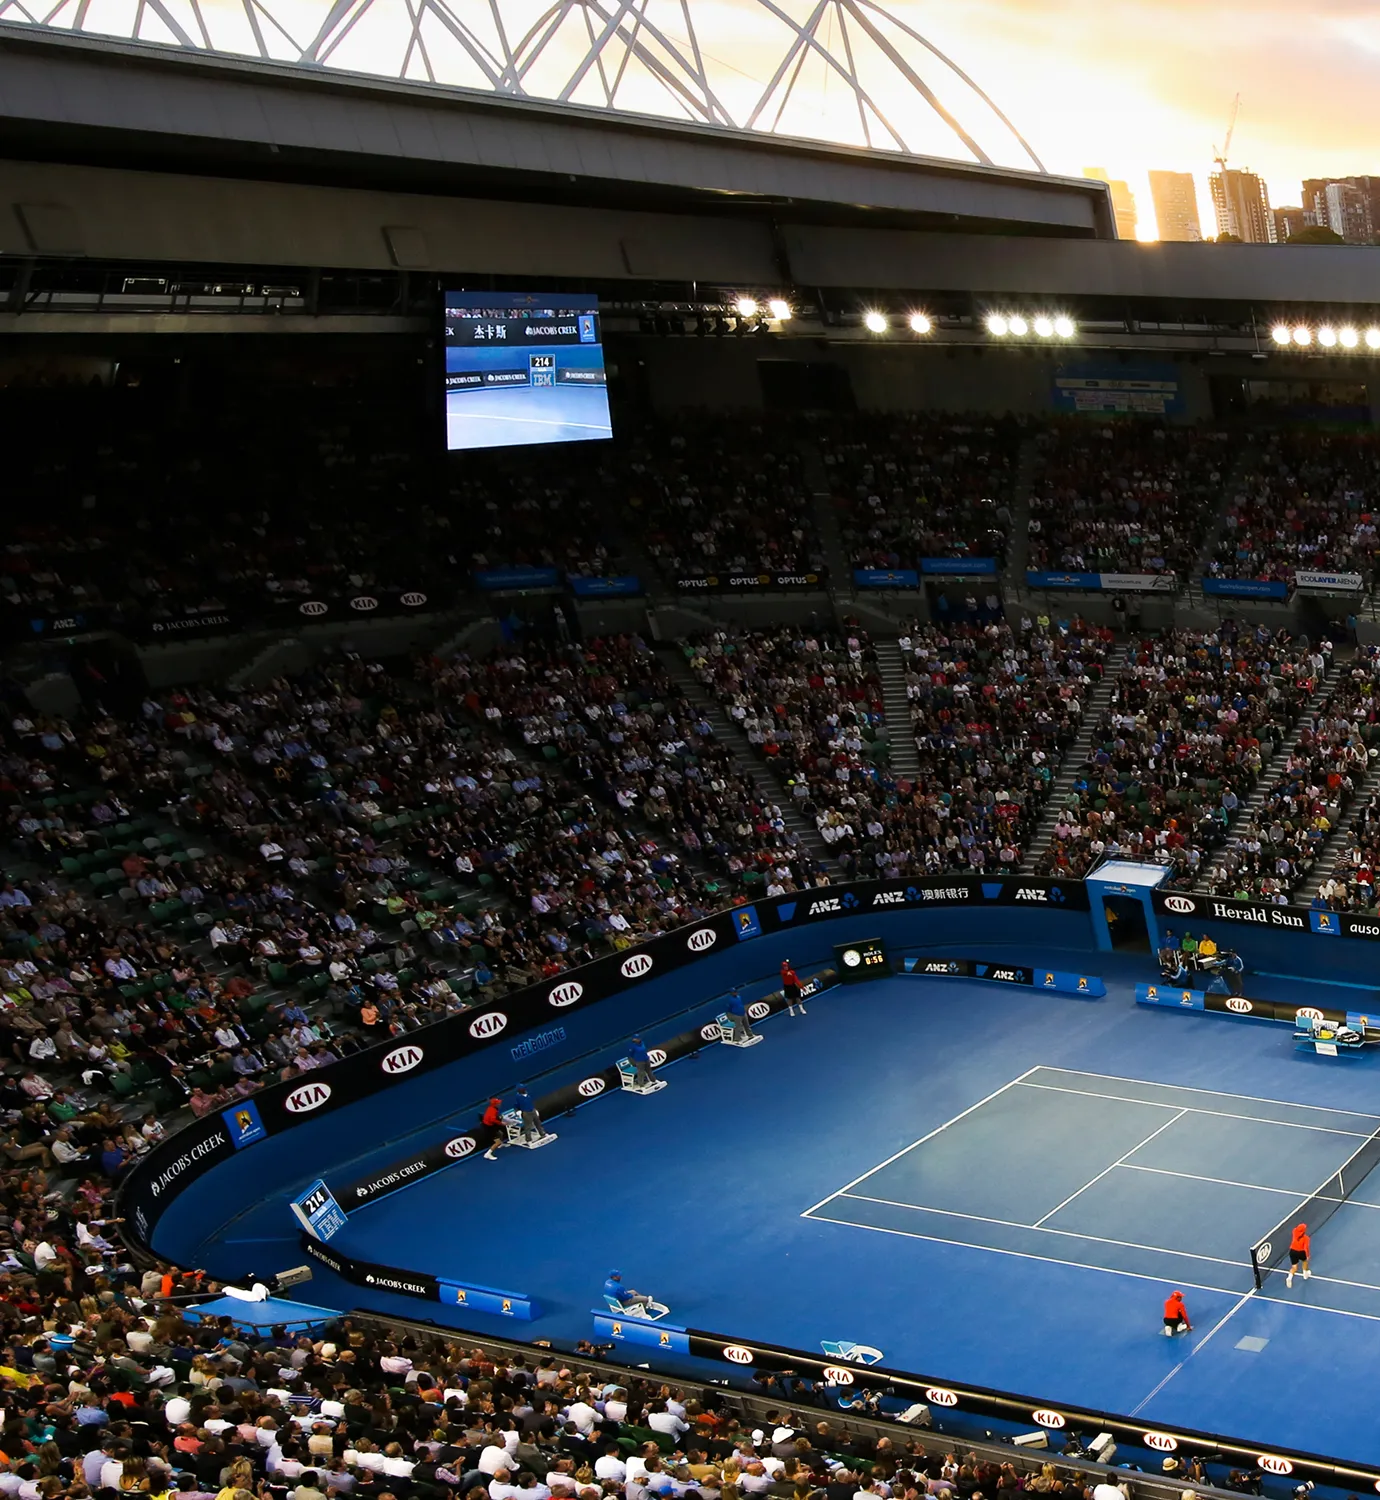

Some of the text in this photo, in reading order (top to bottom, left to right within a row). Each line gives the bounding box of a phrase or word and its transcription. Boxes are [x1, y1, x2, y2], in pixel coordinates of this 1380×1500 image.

[534, 357, 550, 367] 214
[533, 374, 553, 387] IBM
[730, 577, 759, 586] OPTUS
[777, 576, 806, 585] OPTUS
[354, 599, 376, 608] KIA
[403, 595, 425, 604] KIA
[302, 604, 325, 613] KIA
[53, 618, 77, 631] ANZ
[201, 613, 231, 627] CREEK
[872, 887, 969, 905] ANZ 澳新银行
[1015, 888, 1048, 902] ANZ
[808, 898, 842, 915] ANZ
[1168, 898, 1192, 911] KIA
[1212, 902, 1304, 927] Herald Sun
[690, 932, 715, 949] KIA
[624, 956, 651, 976] KIA
[865, 954, 883, 965] 0:56
[924, 963, 948, 973] ANZ
[993, 969, 1015, 980] ANZ
[552, 984, 580, 1004] KIA
[750, 1004, 769, 1017] KIA
[1229, 1000, 1249, 1010] KIA
[473, 1015, 504, 1036] KIA
[511, 1027, 567, 1062] MELBOURNE
[386, 1049, 420, 1072] KIA
[580, 1080, 604, 1095] KIA
[290, 1086, 327, 1110] KIA
[448, 1139, 474, 1156] KIA
[158, 1153, 192, 1190] JACOB'S
[190, 1132, 226, 1161] CREEK
[367, 1160, 427, 1194] JACOB'S CREEK
[305, 1190, 325, 1213] 214
[317, 1208, 345, 1241] IBM
[375, 1277, 426, 1294] JACOB'S CREEK
[727, 1349, 750, 1362] KIA
[827, 1369, 850, 1383] KIA
[930, 1390, 953, 1404] KIA
[1037, 1412, 1061, 1426] KIA
[1148, 1435, 1173, 1449] KIA
[1262, 1457, 1287, 1472] KIA
